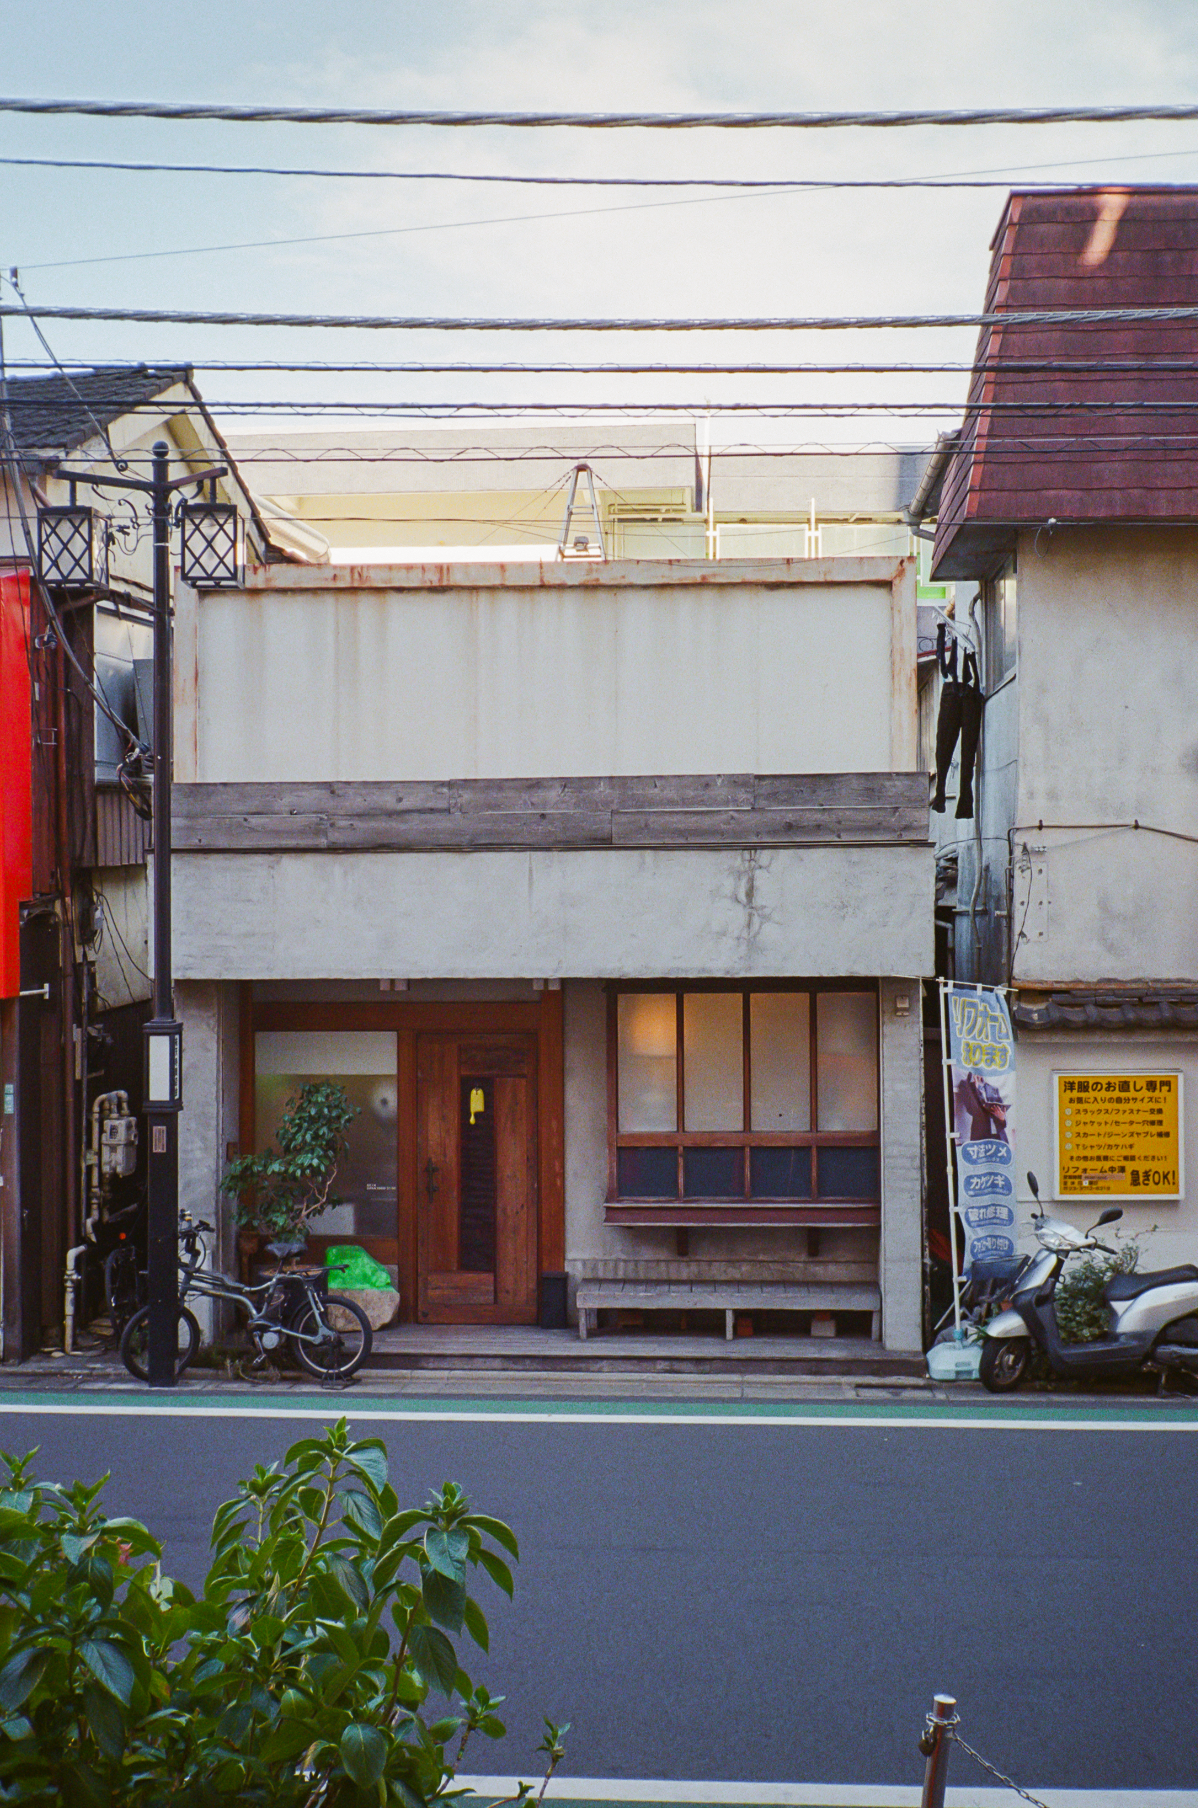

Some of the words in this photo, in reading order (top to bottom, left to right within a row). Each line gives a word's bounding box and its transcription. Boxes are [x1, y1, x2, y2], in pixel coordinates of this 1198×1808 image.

[1063, 1080, 1172, 1093] 洋服のお直し専門
[1130, 1168, 1176, 1187] 急ぎOK!
